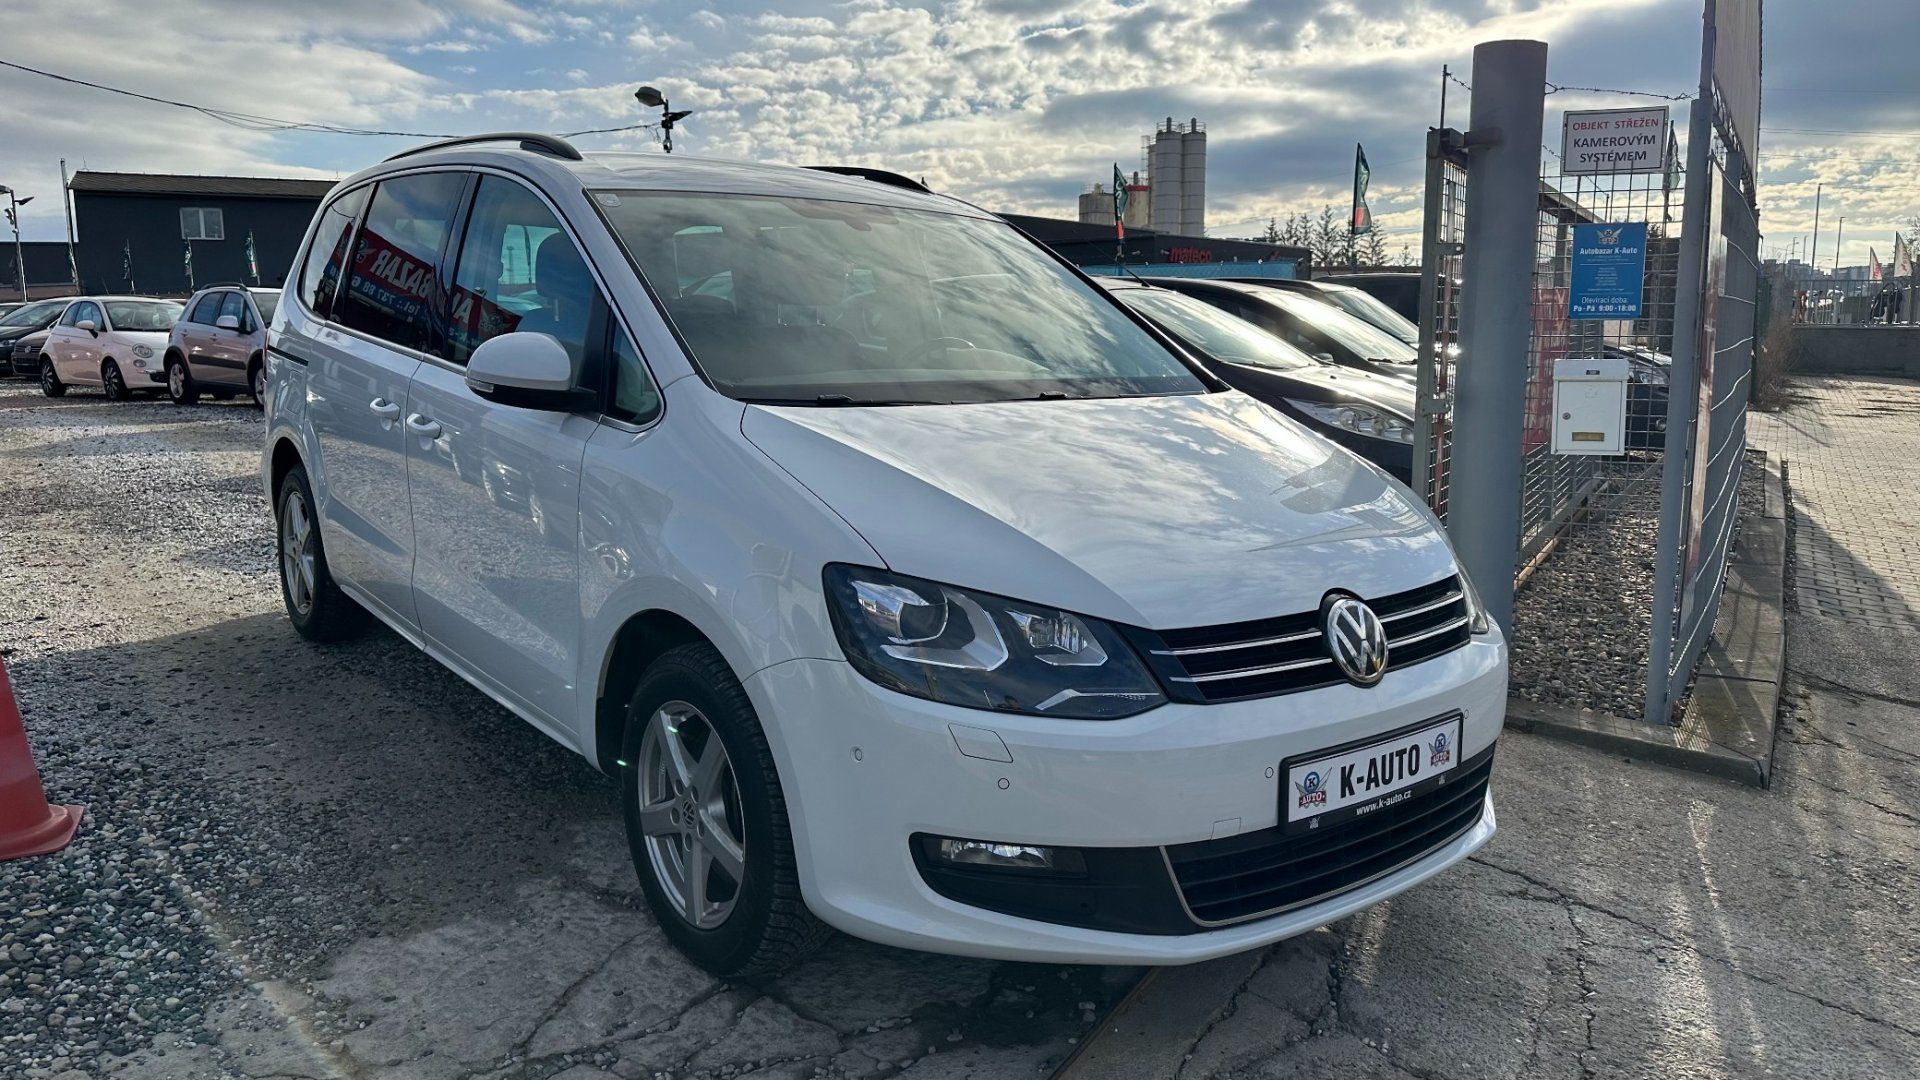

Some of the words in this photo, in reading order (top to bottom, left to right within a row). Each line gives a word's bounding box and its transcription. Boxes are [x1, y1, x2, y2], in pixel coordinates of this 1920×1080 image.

[1572, 121, 1609, 131] OBJEKT
[1614, 117, 1659, 129] STŘEŽEN
[1573, 133, 1656, 148] KAMEROVÝM
[1580, 150, 1647, 163] SYSTÉMEM
[1580, 247, 1613, 255] Autobazar
[1614, 246, 1638, 254] K-Auto
[1340, 743, 1421, 799] K-AUTO
[1355, 789, 1412, 816] www.k-auto.cz
